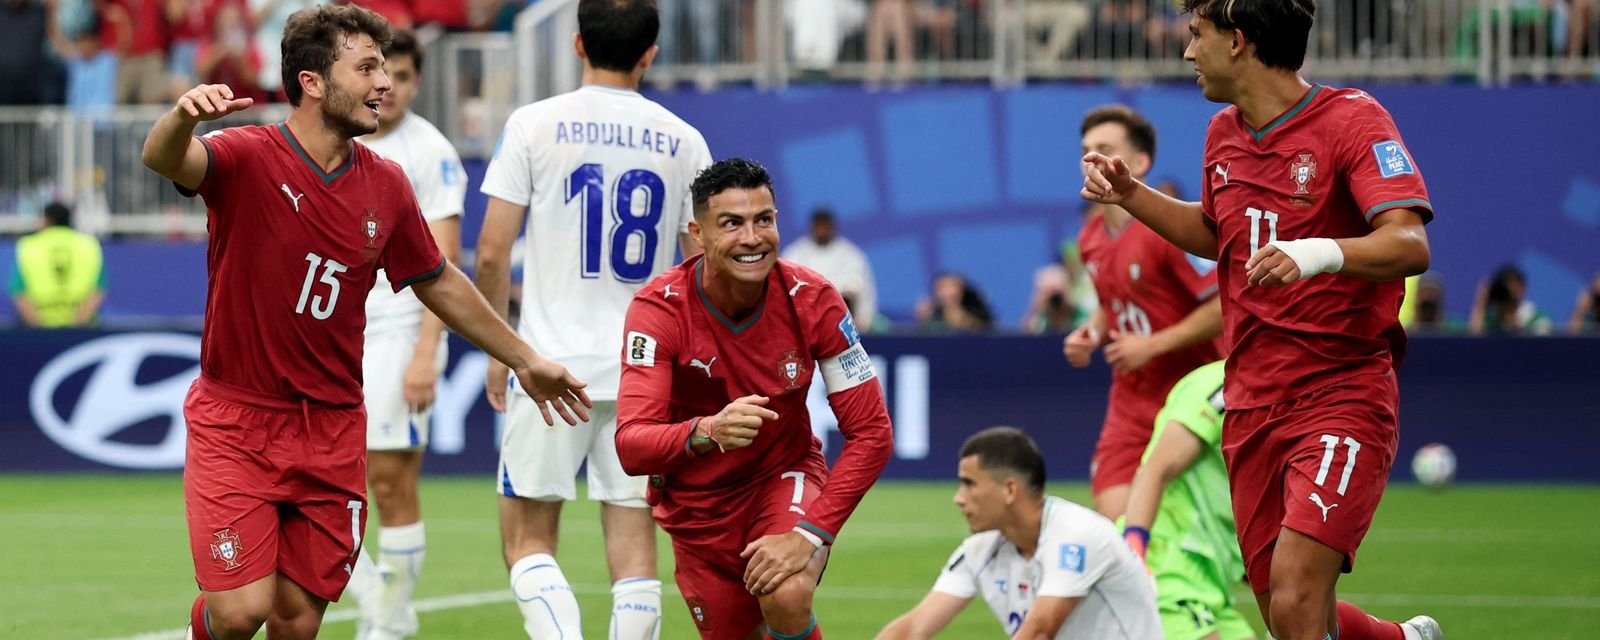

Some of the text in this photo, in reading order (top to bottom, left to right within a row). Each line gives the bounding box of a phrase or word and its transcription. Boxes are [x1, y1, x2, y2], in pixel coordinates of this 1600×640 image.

[556, 121, 681, 158] ABDULLAEV
[564, 163, 666, 284] 18
[1245, 207, 1279, 258] 11
[295, 252, 349, 320] 15
[781, 471, 806, 504] 7
[1314, 434, 1361, 497] 11
